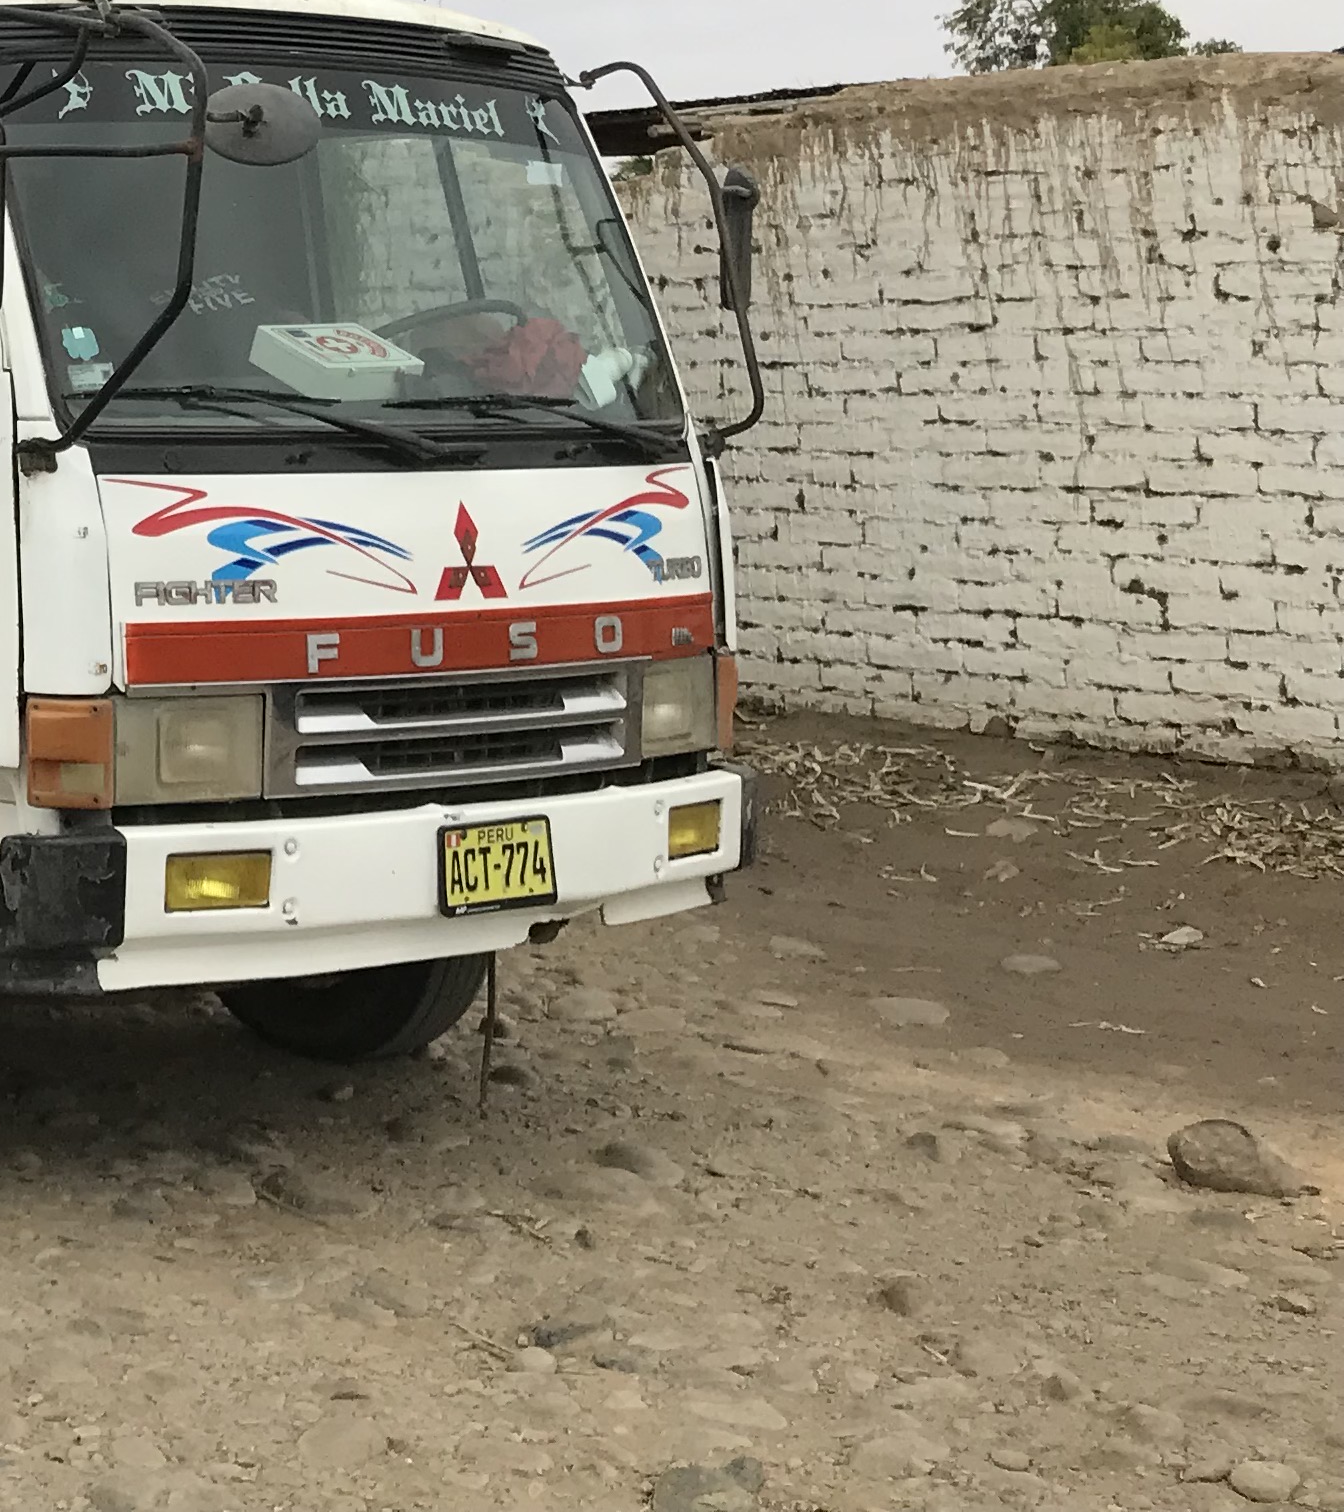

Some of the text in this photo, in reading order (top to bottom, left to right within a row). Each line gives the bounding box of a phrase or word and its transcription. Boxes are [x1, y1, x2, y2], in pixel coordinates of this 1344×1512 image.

[362, 80, 505, 138] Mariel
[647, 555, 702, 582] TURBO
[134, 578, 278, 607] FIGHTER
[306, 615, 624, 675] FUSO
[477, 828, 514, 845] PERU
[451, 839, 547, 896] ACT-774
